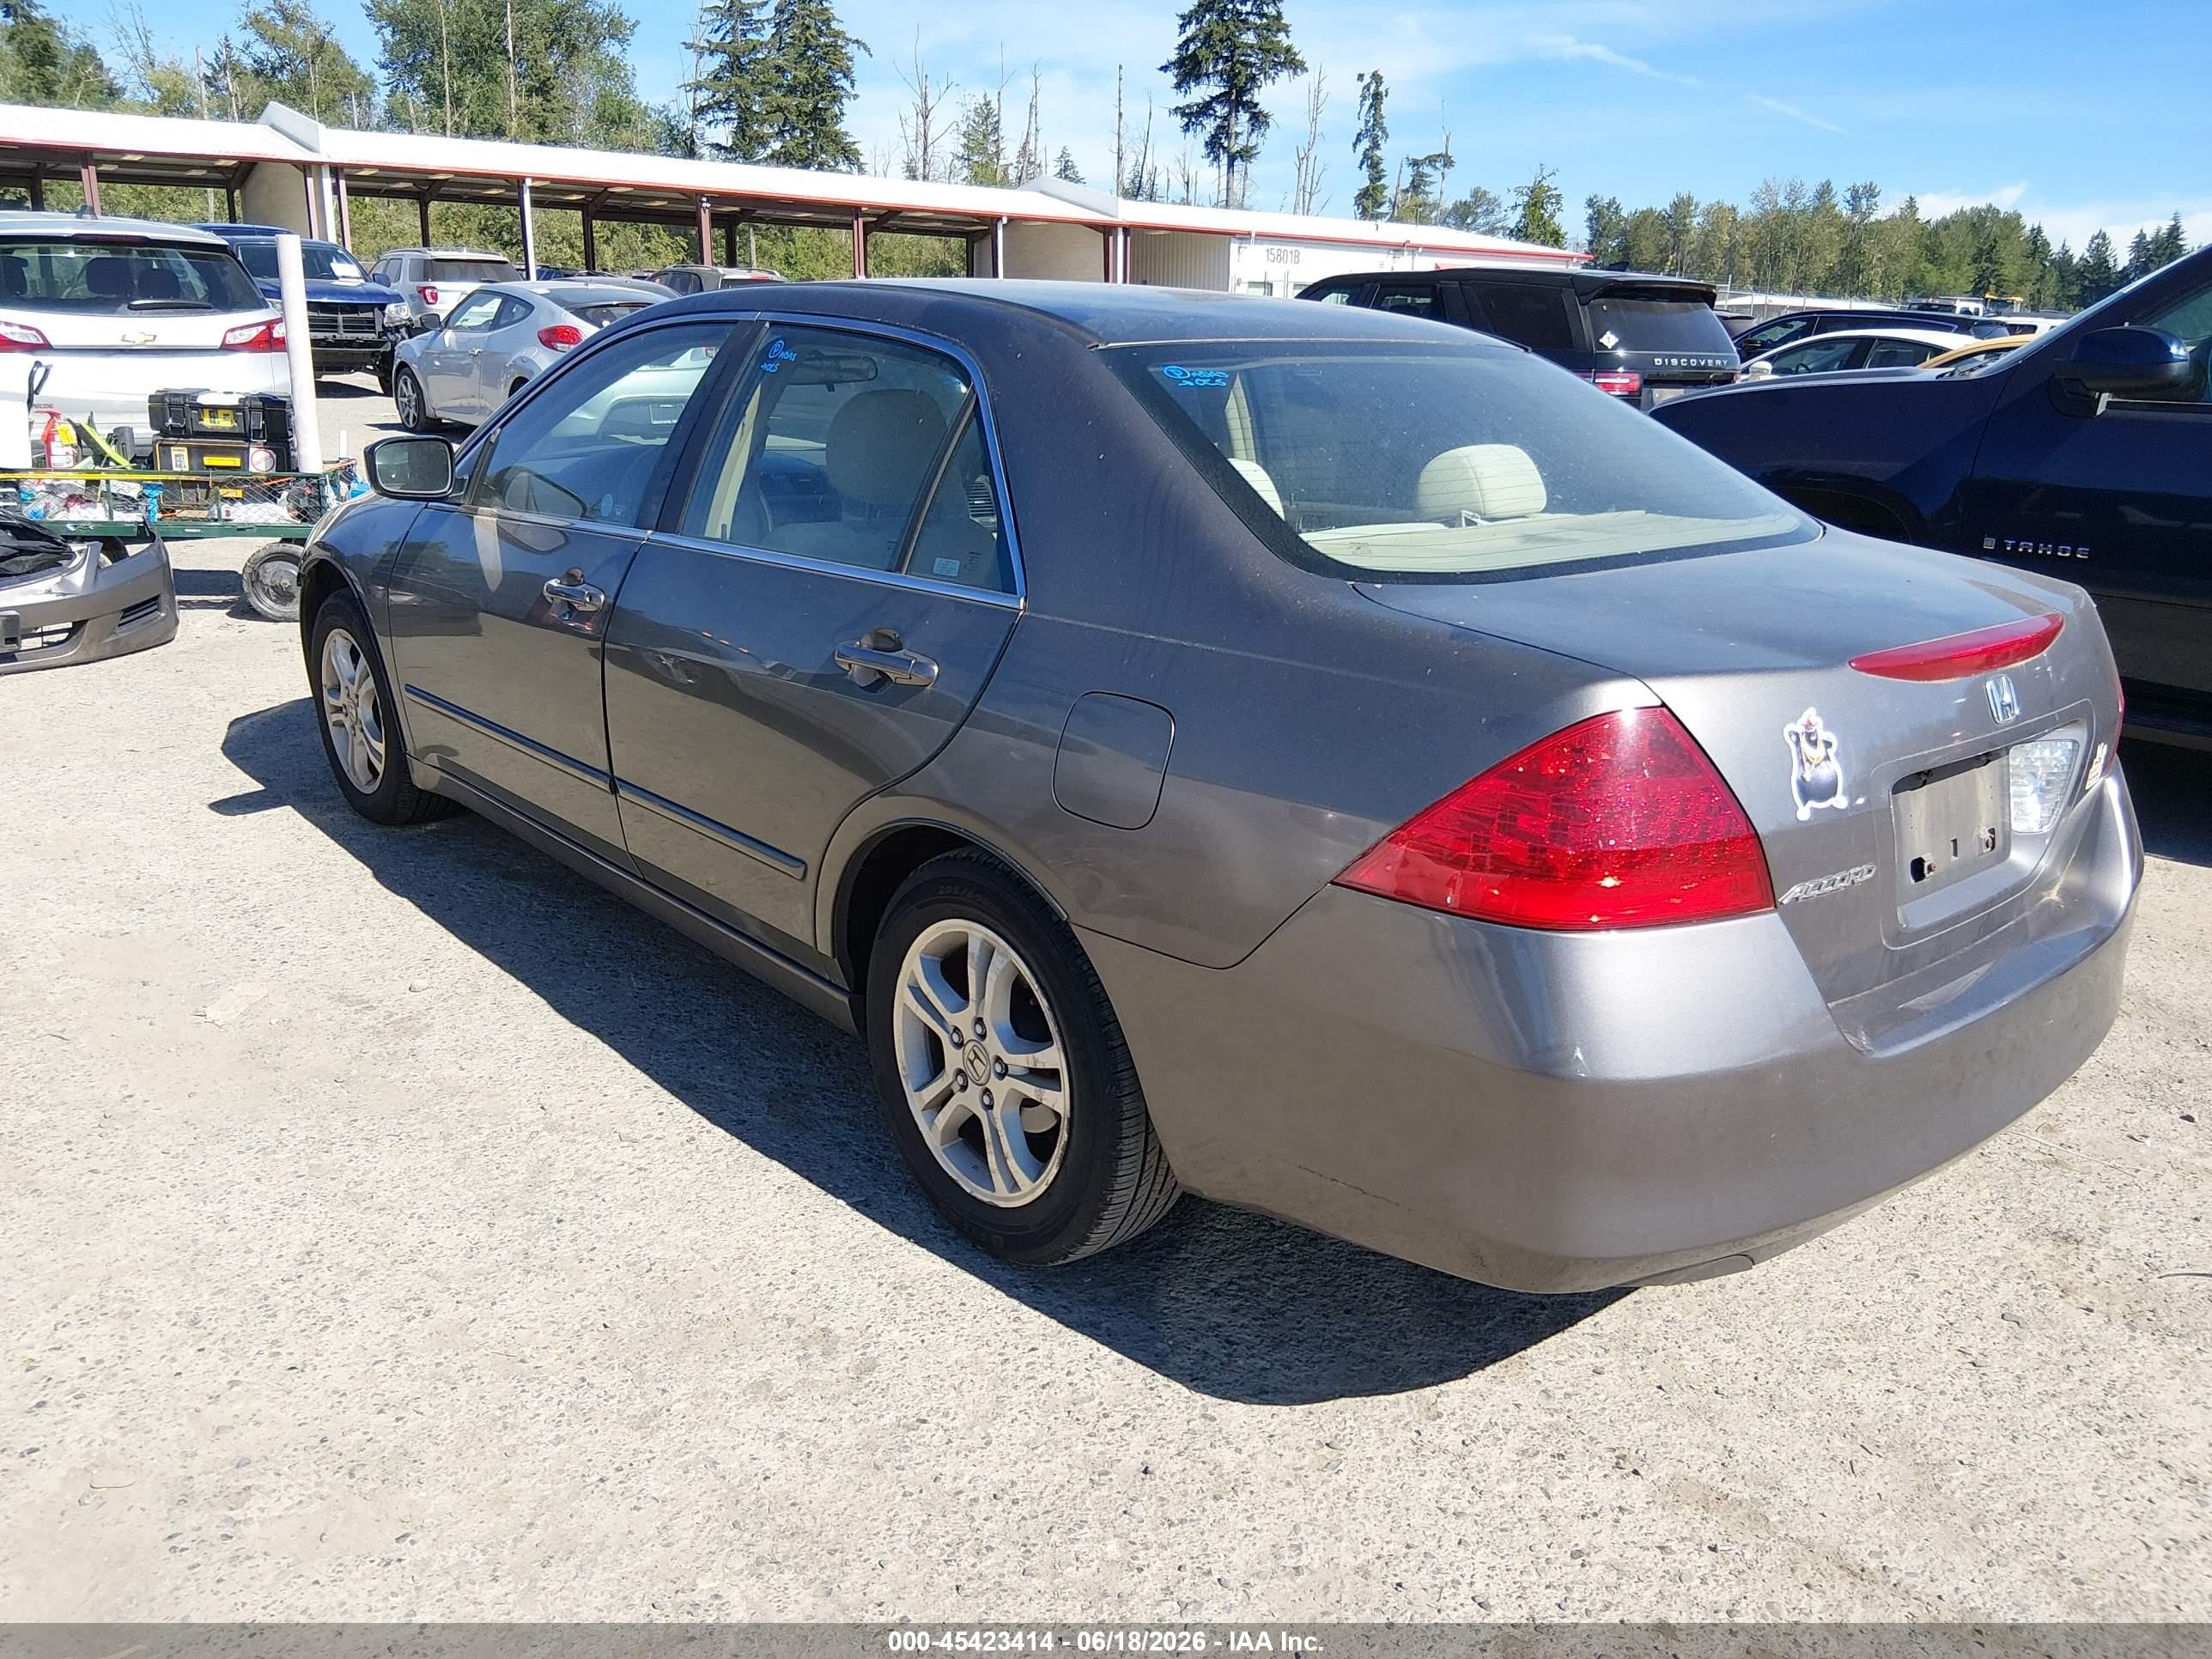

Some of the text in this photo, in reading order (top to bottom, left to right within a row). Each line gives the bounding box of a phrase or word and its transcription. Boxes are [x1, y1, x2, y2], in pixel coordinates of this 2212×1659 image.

[1265, 247, 1300, 264] 15801B
[1654, 357, 1728, 367] DISCOVERY
[2003, 539, 2091, 559] TAHOE
[1778, 864, 1876, 905] ACCORD
